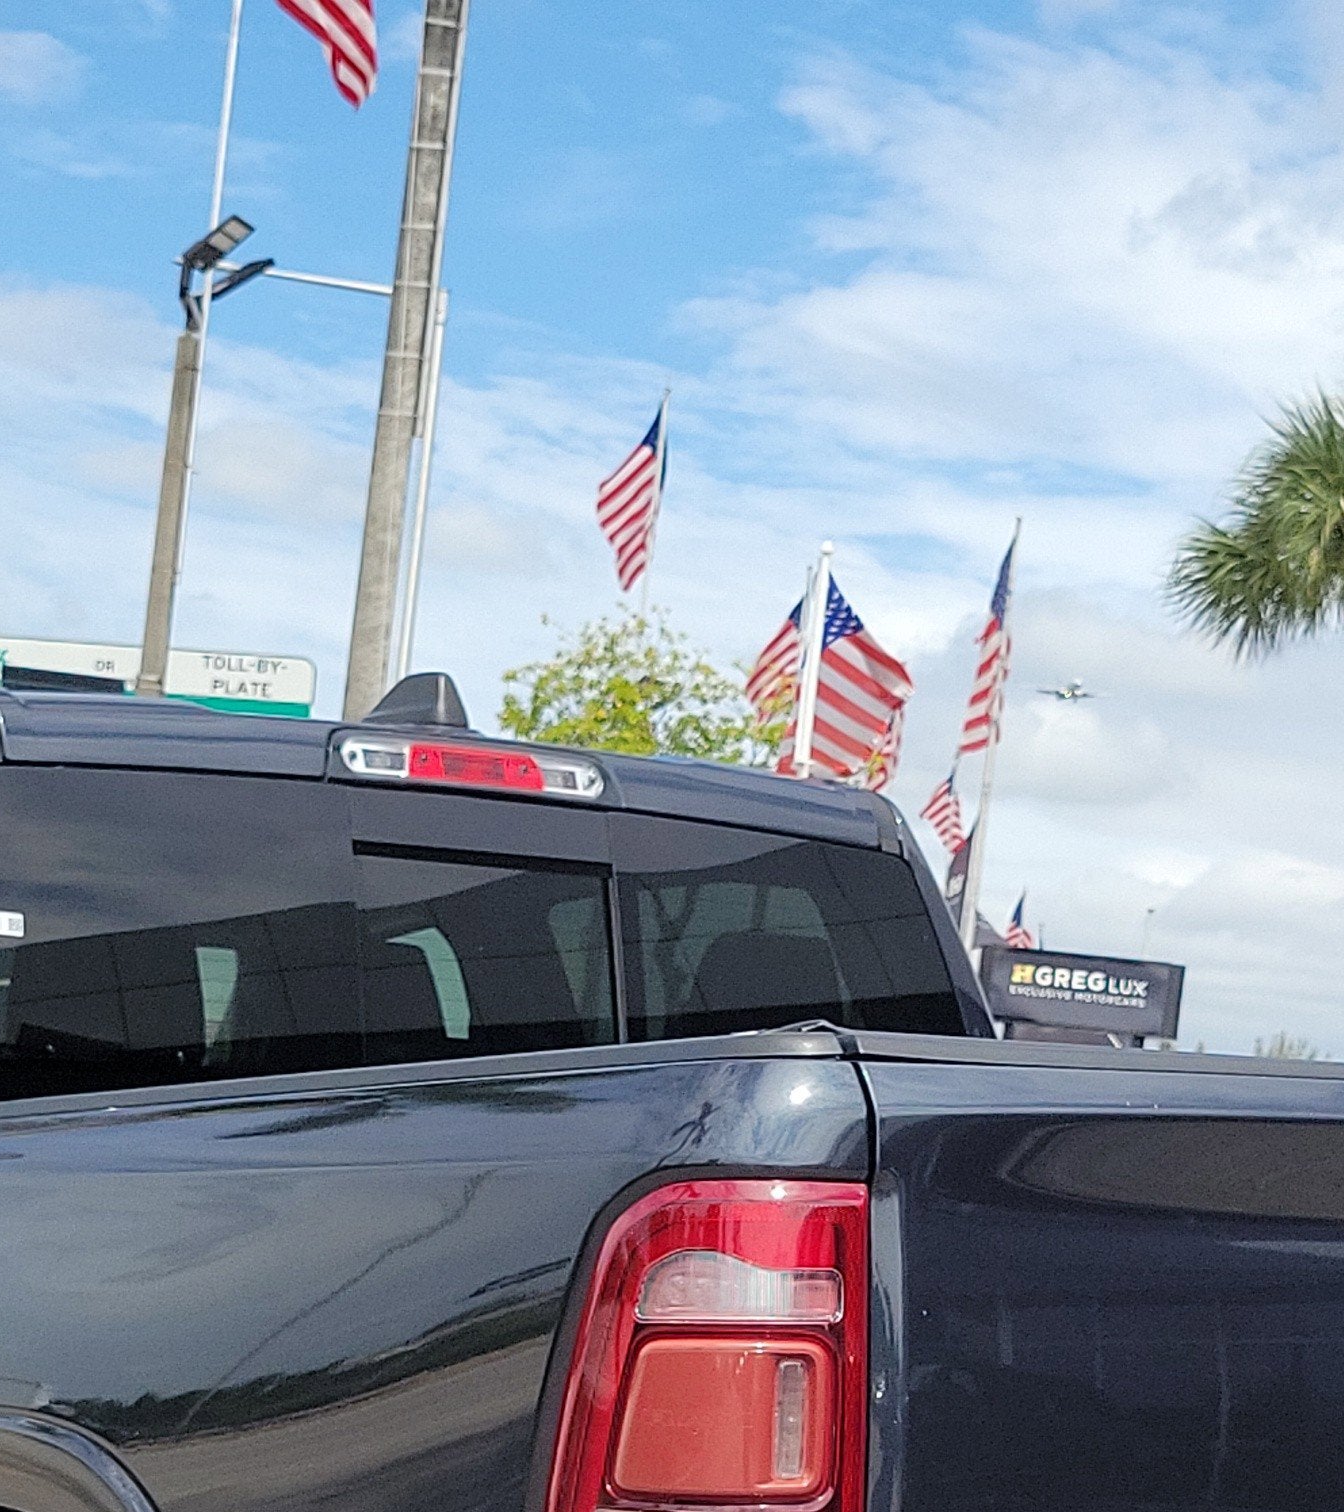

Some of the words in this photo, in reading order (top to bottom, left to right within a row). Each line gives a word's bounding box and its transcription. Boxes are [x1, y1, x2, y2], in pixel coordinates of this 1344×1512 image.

[94, 659, 116, 673] OR
[202, 655, 288, 676] TOLL-BY-
[211, 679, 272, 699] PLATE
[1107, 975, 1150, 998] LUX
